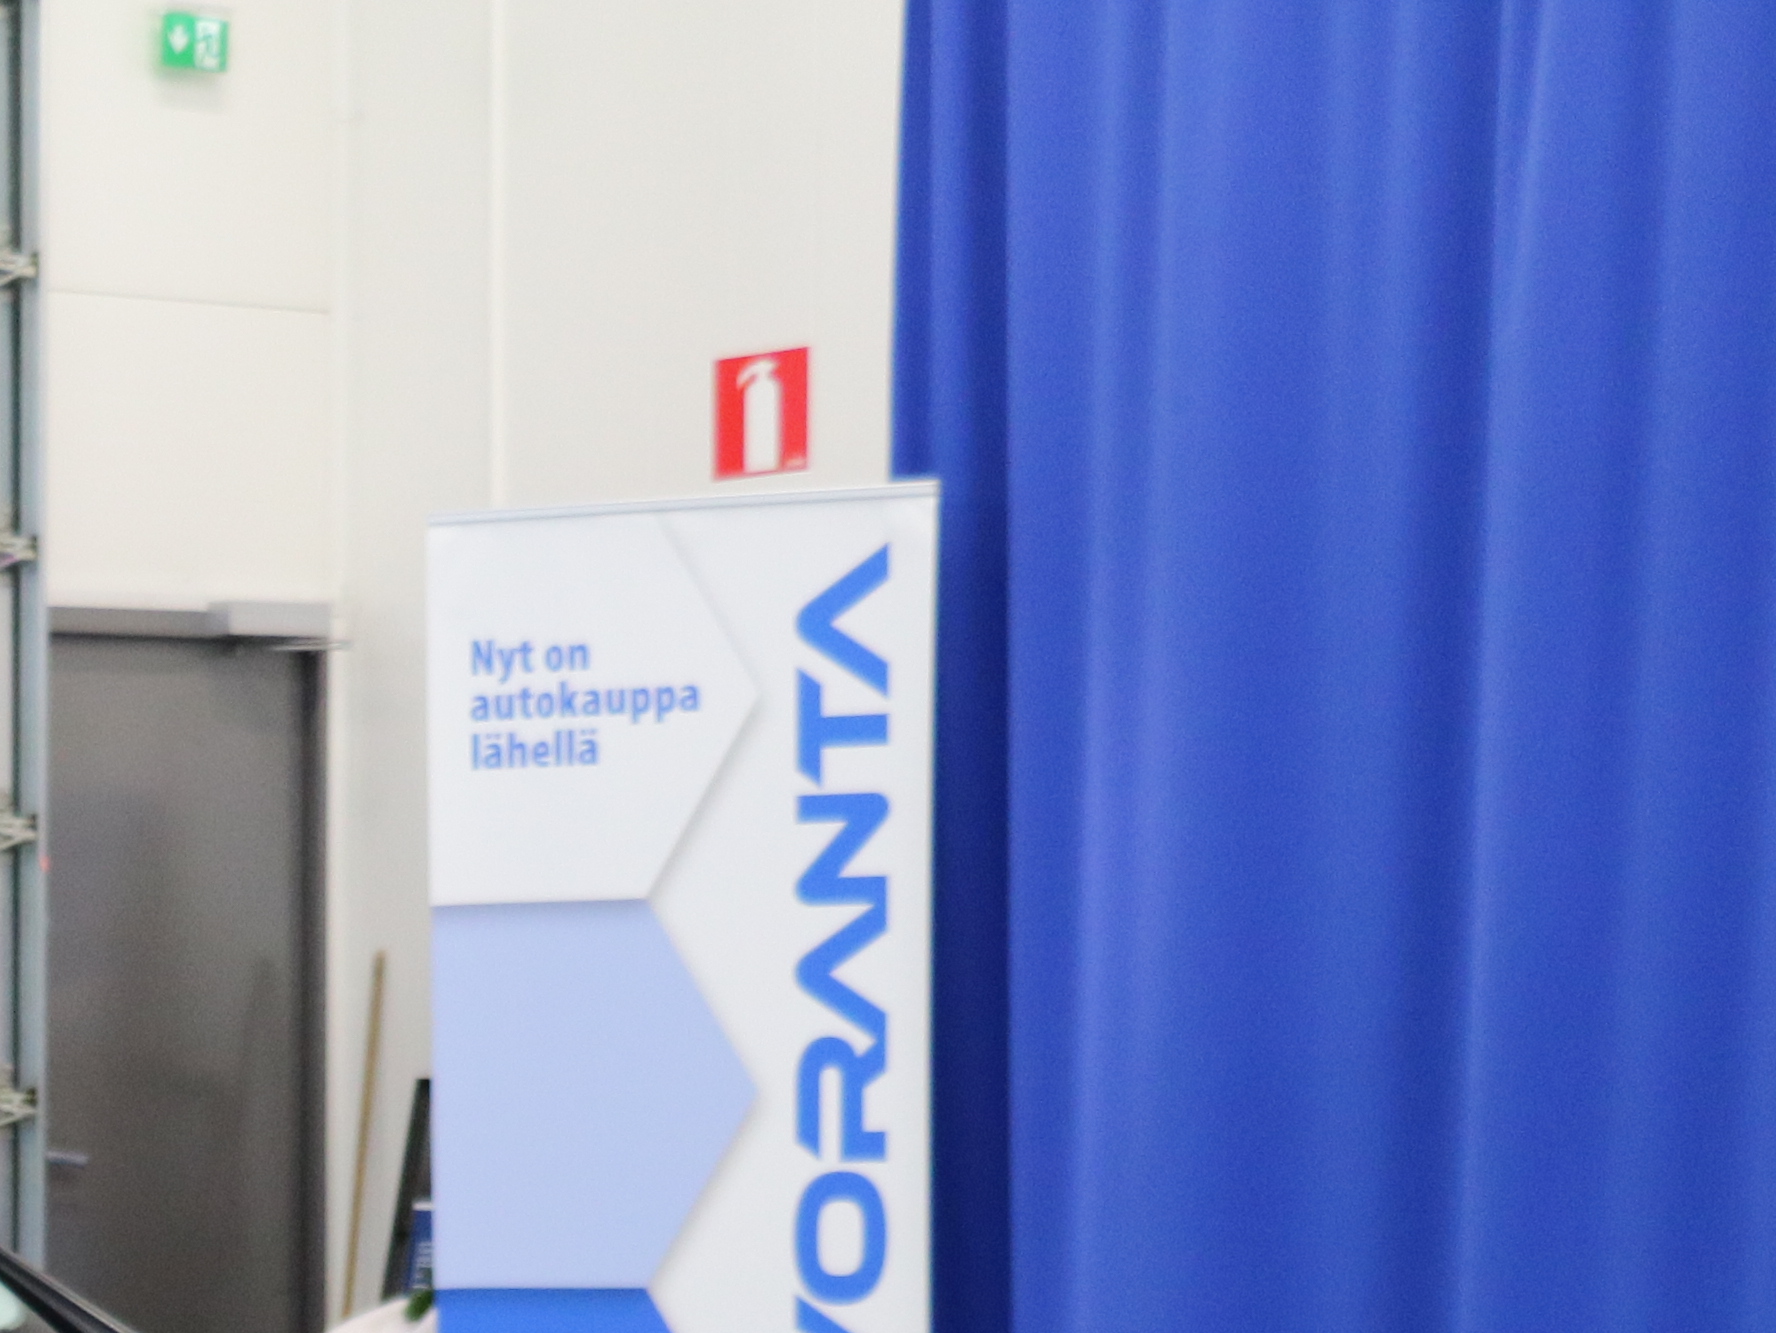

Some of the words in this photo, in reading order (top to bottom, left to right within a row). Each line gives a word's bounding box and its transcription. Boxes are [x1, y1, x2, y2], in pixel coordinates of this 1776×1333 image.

[471, 639, 533, 684] Nyt
[545, 643, 590, 672] on
[470, 681, 700, 724] autokauppa
[471, 730, 598, 770] lähellä
